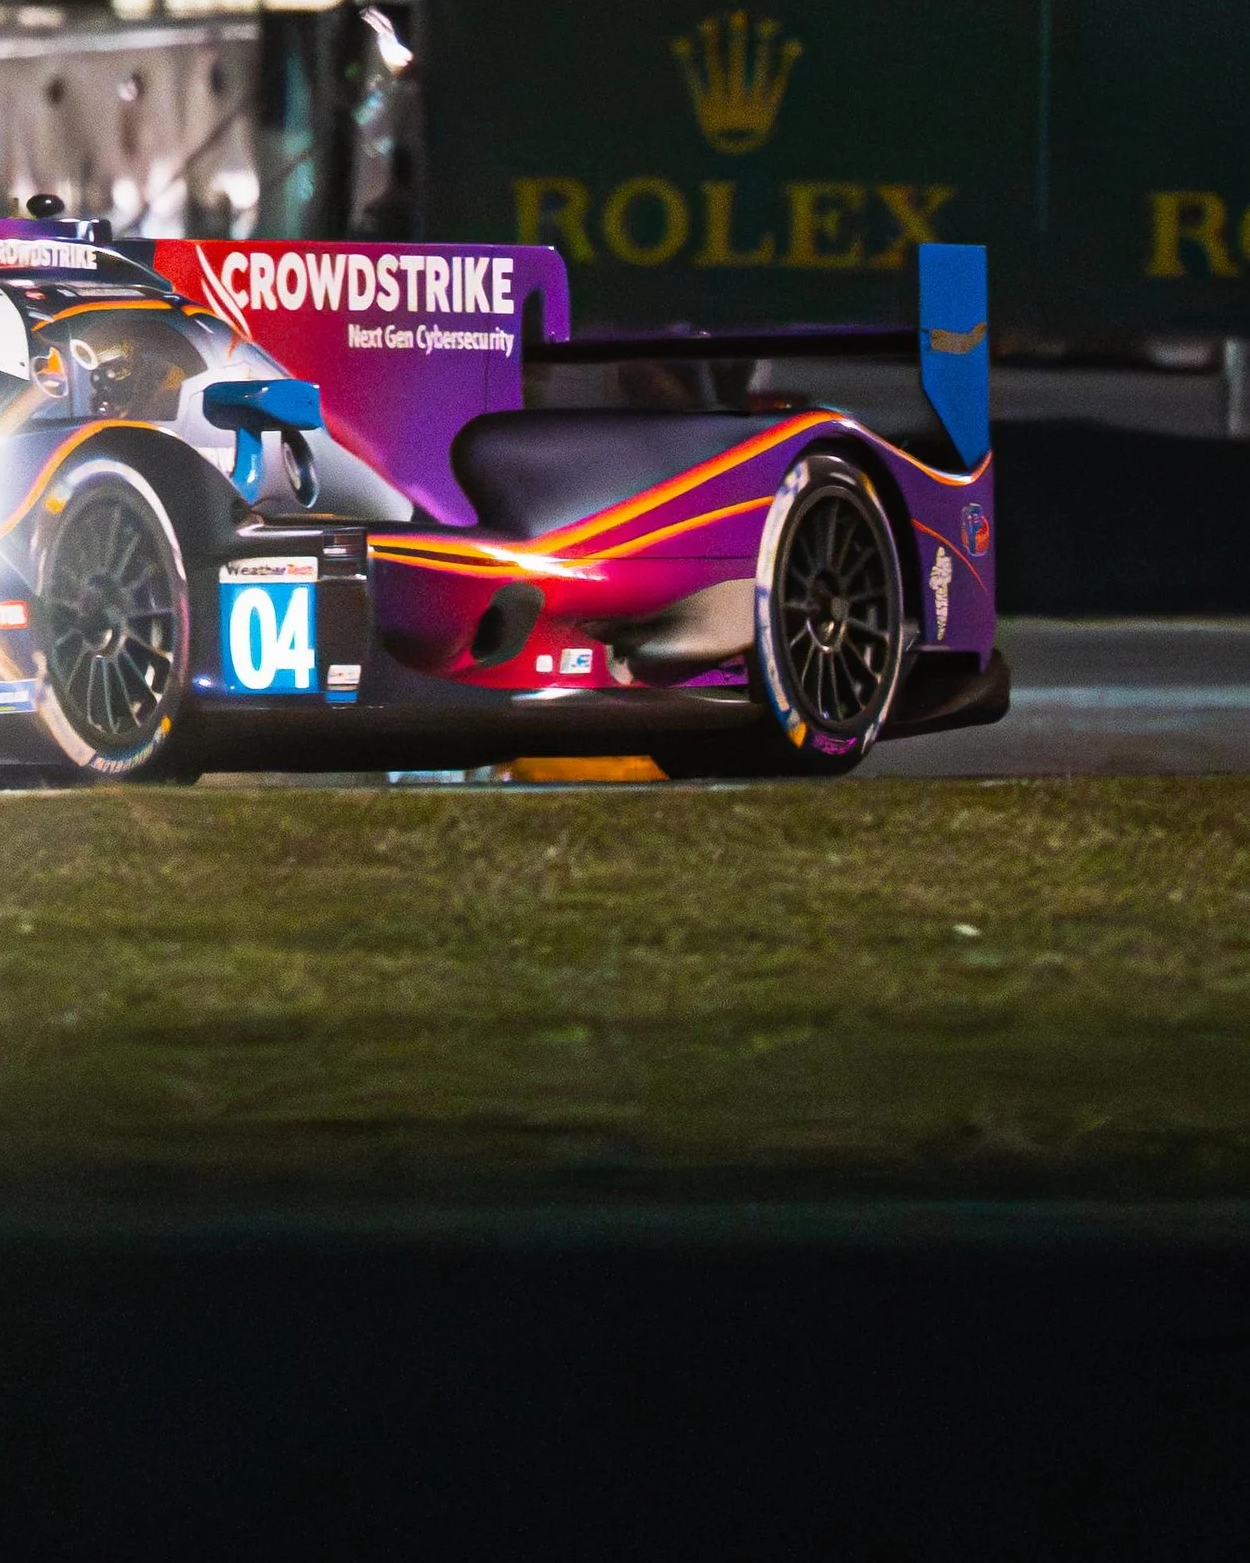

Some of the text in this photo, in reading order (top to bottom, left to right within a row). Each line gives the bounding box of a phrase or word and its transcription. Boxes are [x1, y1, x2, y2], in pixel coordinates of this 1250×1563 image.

[512, 176, 956, 270] ROLEX
[1146, 191, 1250, 279] R
[221, 251, 514, 314] CROWDSTRIKE
[348, 324, 514, 357] Next Gen Cybersecurity
[230, 587, 315, 689] 04
